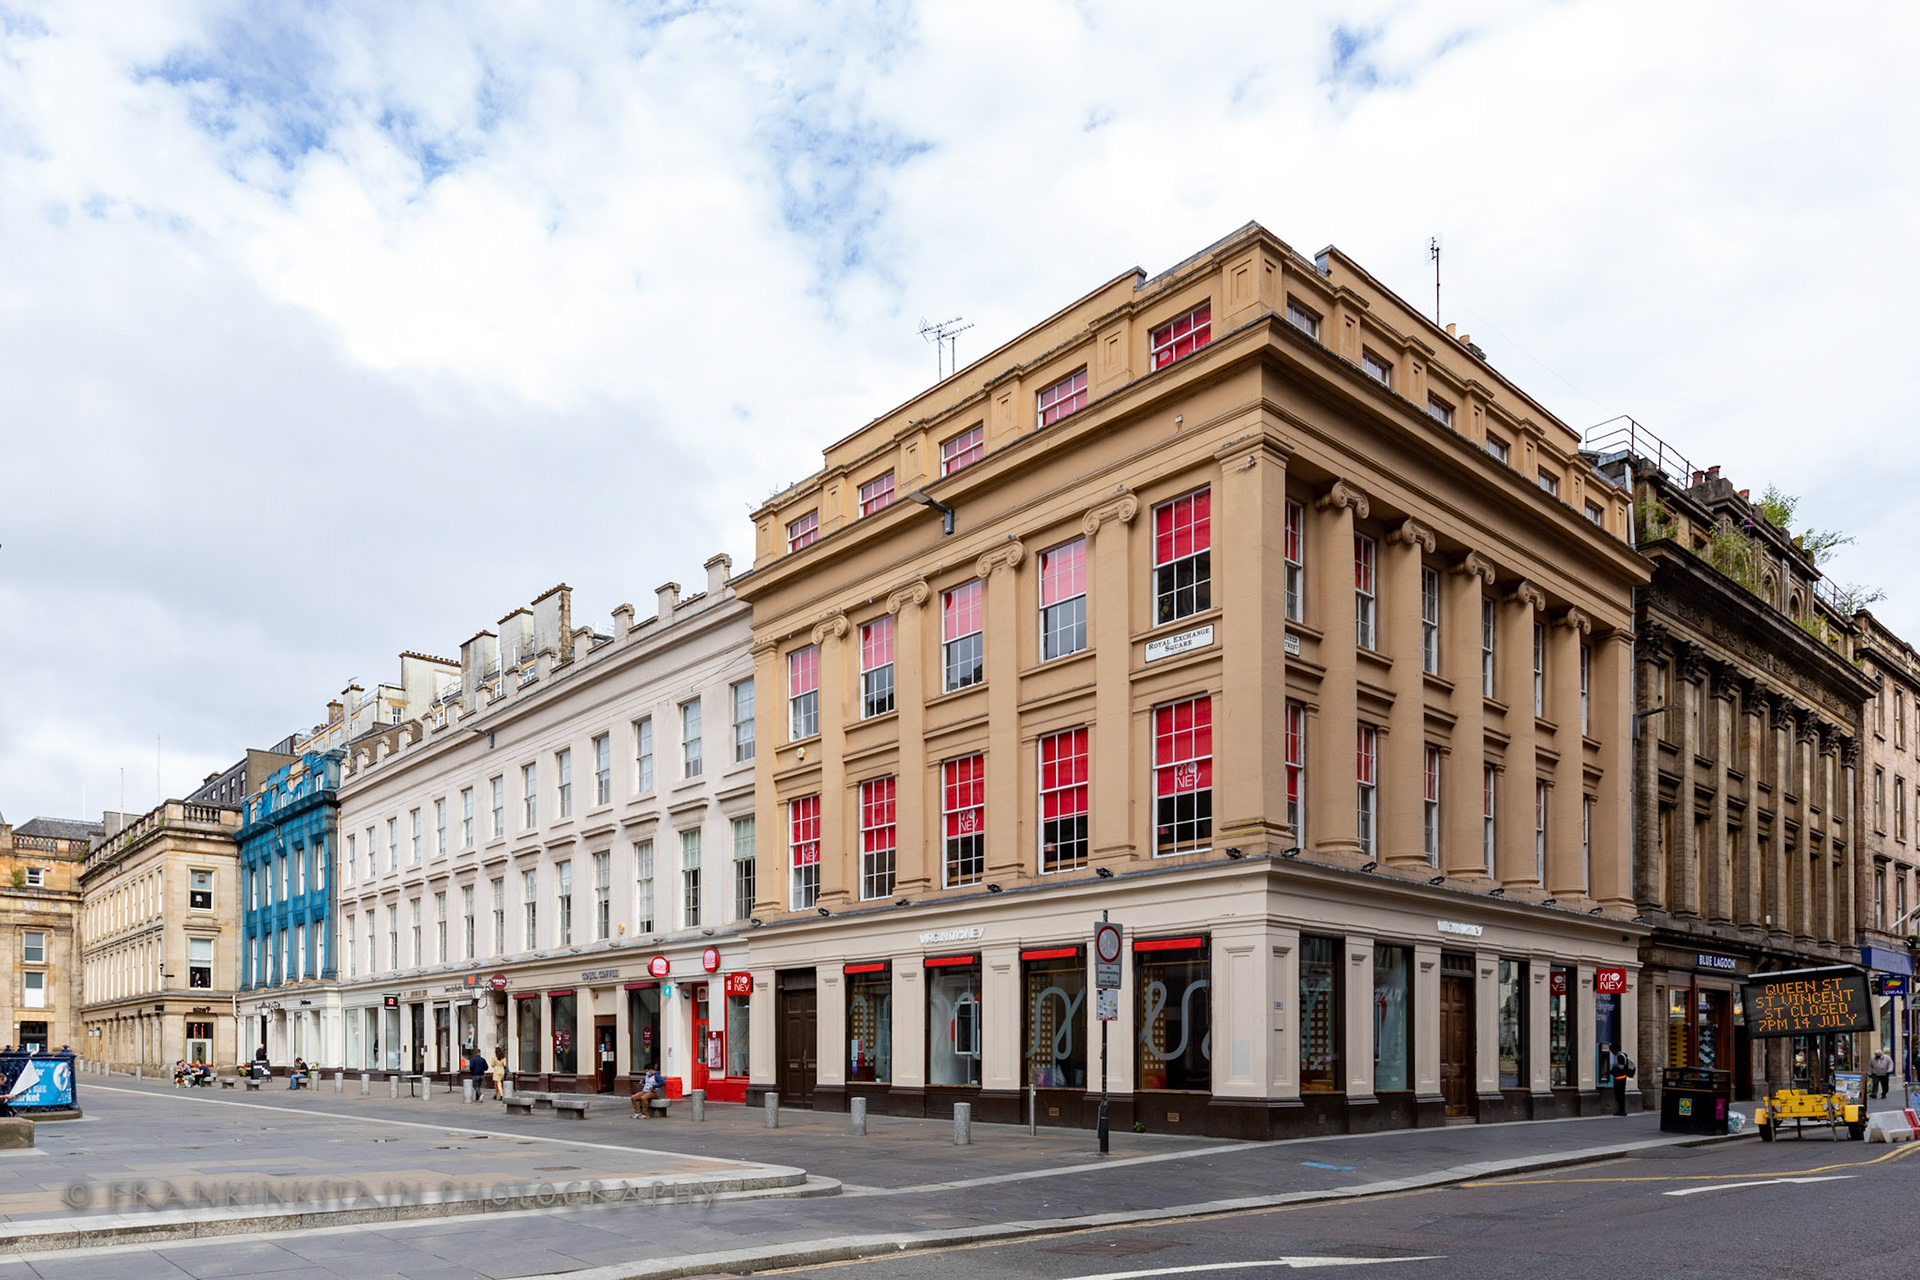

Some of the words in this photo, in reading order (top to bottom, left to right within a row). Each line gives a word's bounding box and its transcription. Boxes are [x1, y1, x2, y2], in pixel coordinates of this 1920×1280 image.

[1148, 638, 1171, 650] ROYAL
[1173, 627, 1210, 643] EXCHANGE
[1165, 639, 1193, 652] SQUARE
[1284, 641, 1299, 651] TREET
[1699, 954, 1713, 967] BLUE
[1713, 956, 1737, 969] LAGOON
[1765, 980, 1816, 996] QUEEN
[1822, 978, 1842, 991] ST
[1755, 995, 1775, 1008] ST
[1781, 989, 1854, 1006] VINCENT
[1764, 1007, 1784, 1020] ST
[1790, 1002, 1848, 1017] CLOSED
[1758, 1018, 1788, 1032] 7PM
[1794, 1017, 1810, 1029] 14
[1818, 1013, 1857, 1028] JULY
